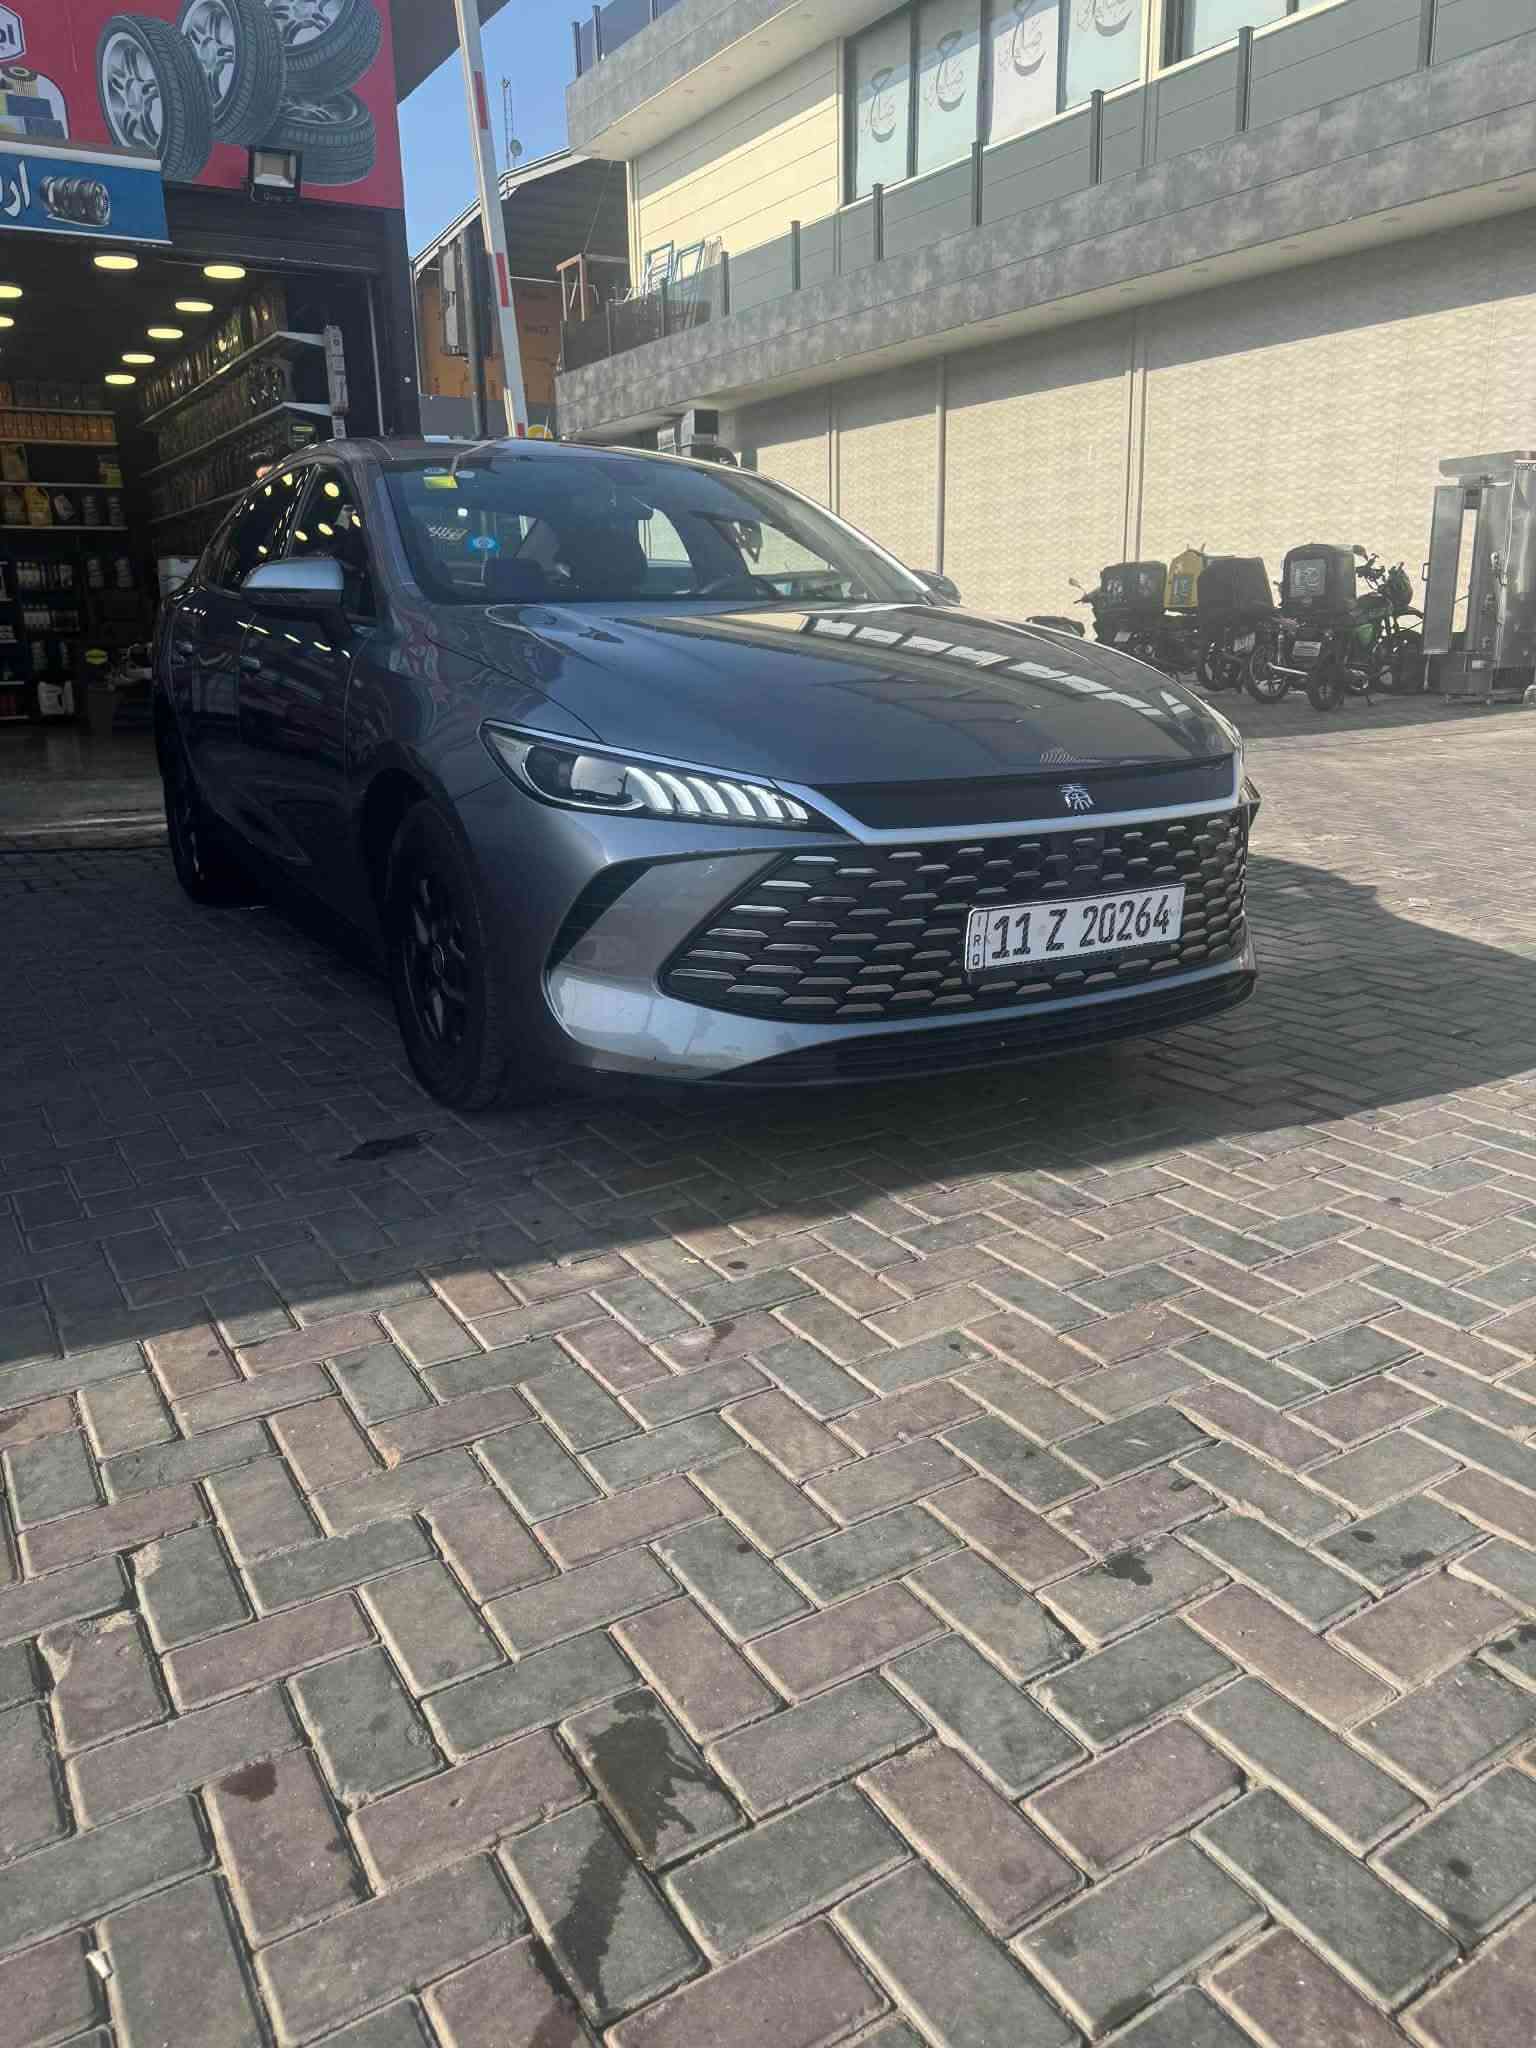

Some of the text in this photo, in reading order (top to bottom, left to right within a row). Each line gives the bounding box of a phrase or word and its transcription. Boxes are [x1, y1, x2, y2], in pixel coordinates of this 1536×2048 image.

[971, 916, 982, 966] IRQ
[992, 894, 1170, 959] 11 Z 20264
